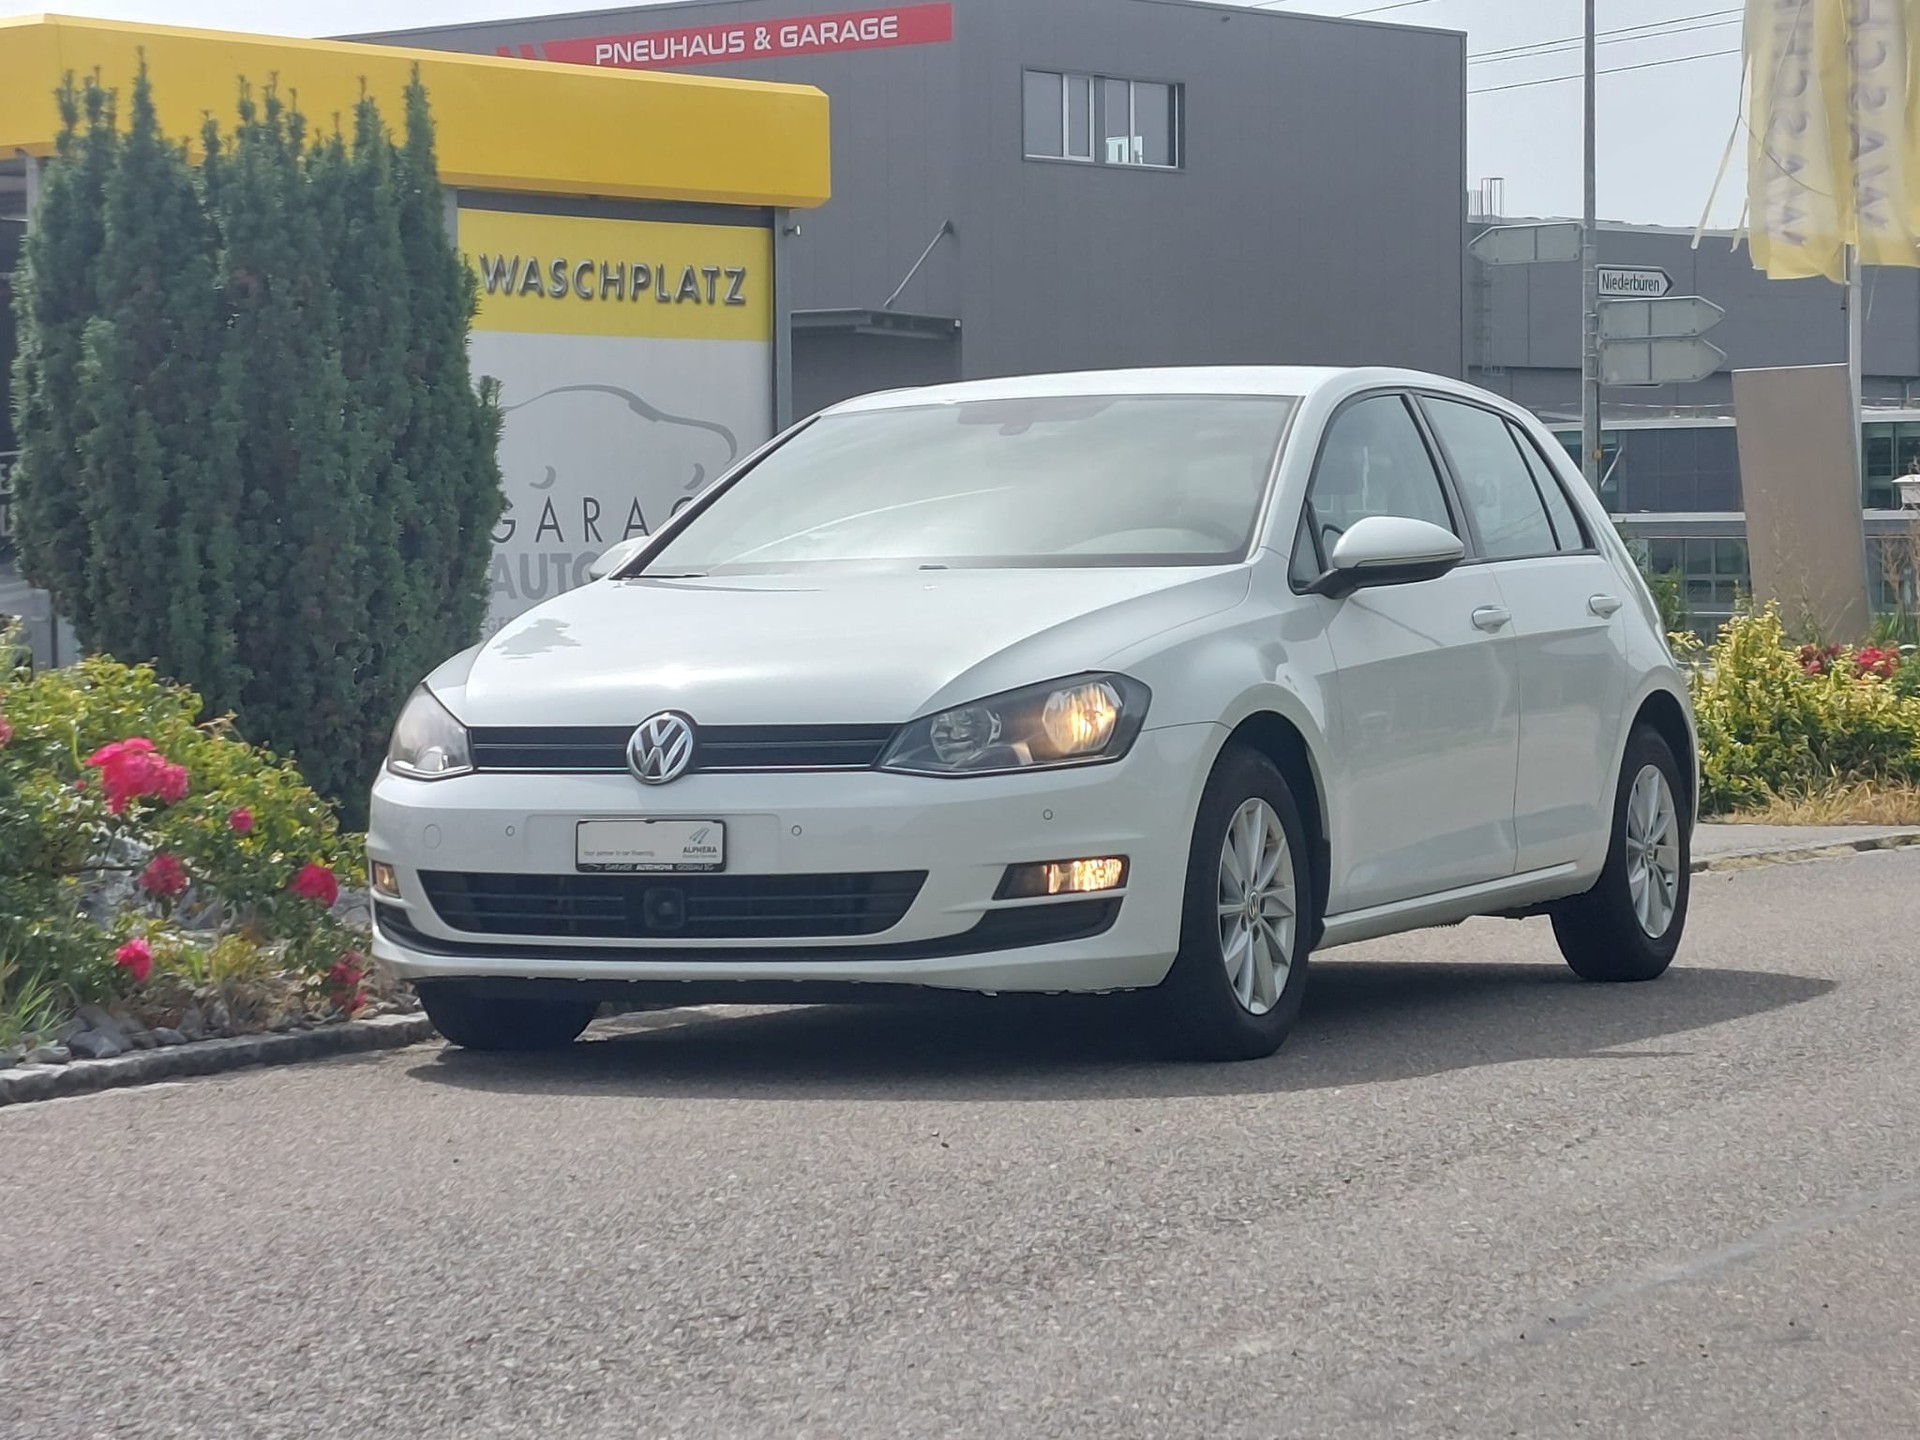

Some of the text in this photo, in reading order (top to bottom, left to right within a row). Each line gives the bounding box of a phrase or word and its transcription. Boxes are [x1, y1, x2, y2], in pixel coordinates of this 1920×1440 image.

[595, 16, 898, 65] PNEUHAUS & GARAGE
[479, 253, 747, 304] WASCHPLATZ
[1602, 272, 1660, 293] Niederbüren
